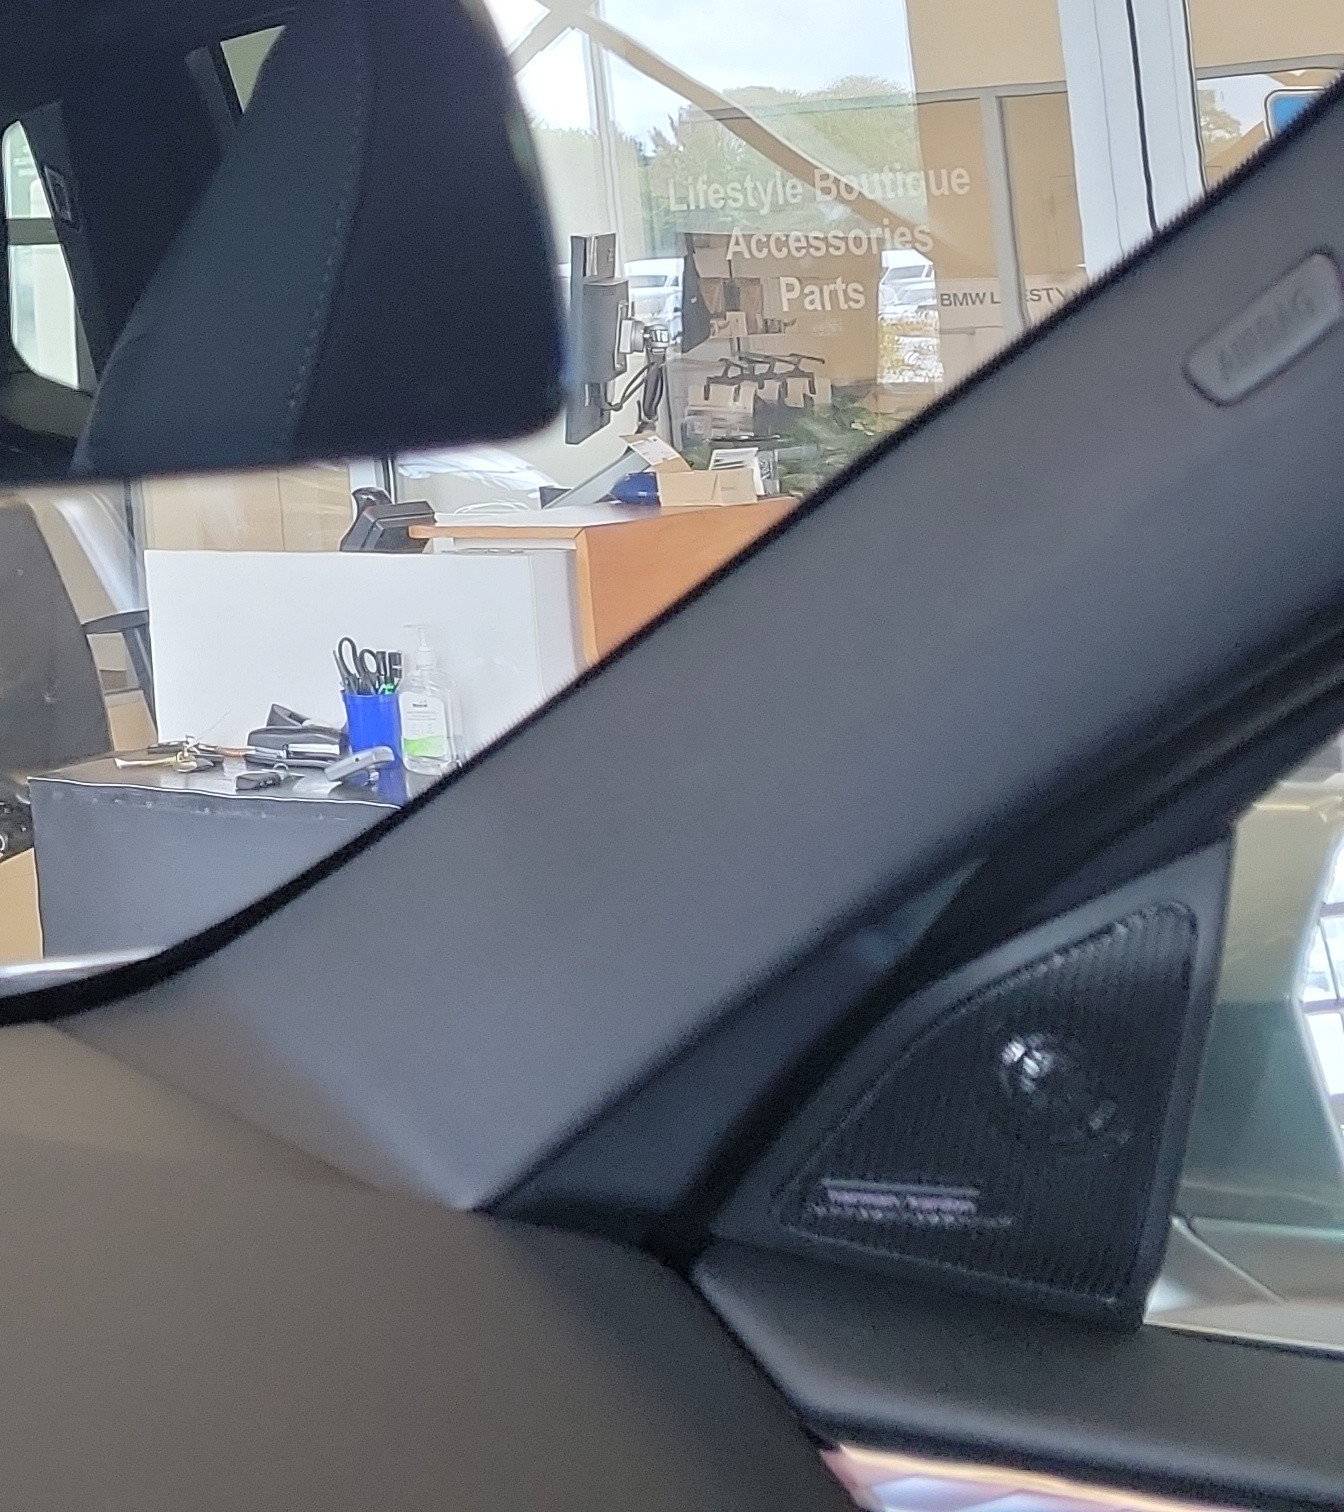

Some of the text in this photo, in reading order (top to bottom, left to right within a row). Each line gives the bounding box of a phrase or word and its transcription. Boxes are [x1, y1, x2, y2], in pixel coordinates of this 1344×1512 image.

[667, 162, 971, 216] Lifestyle Boutique
[725, 218, 935, 261] Accessories
[779, 276, 866, 313] Parts
[940, 291, 987, 307] BMW
